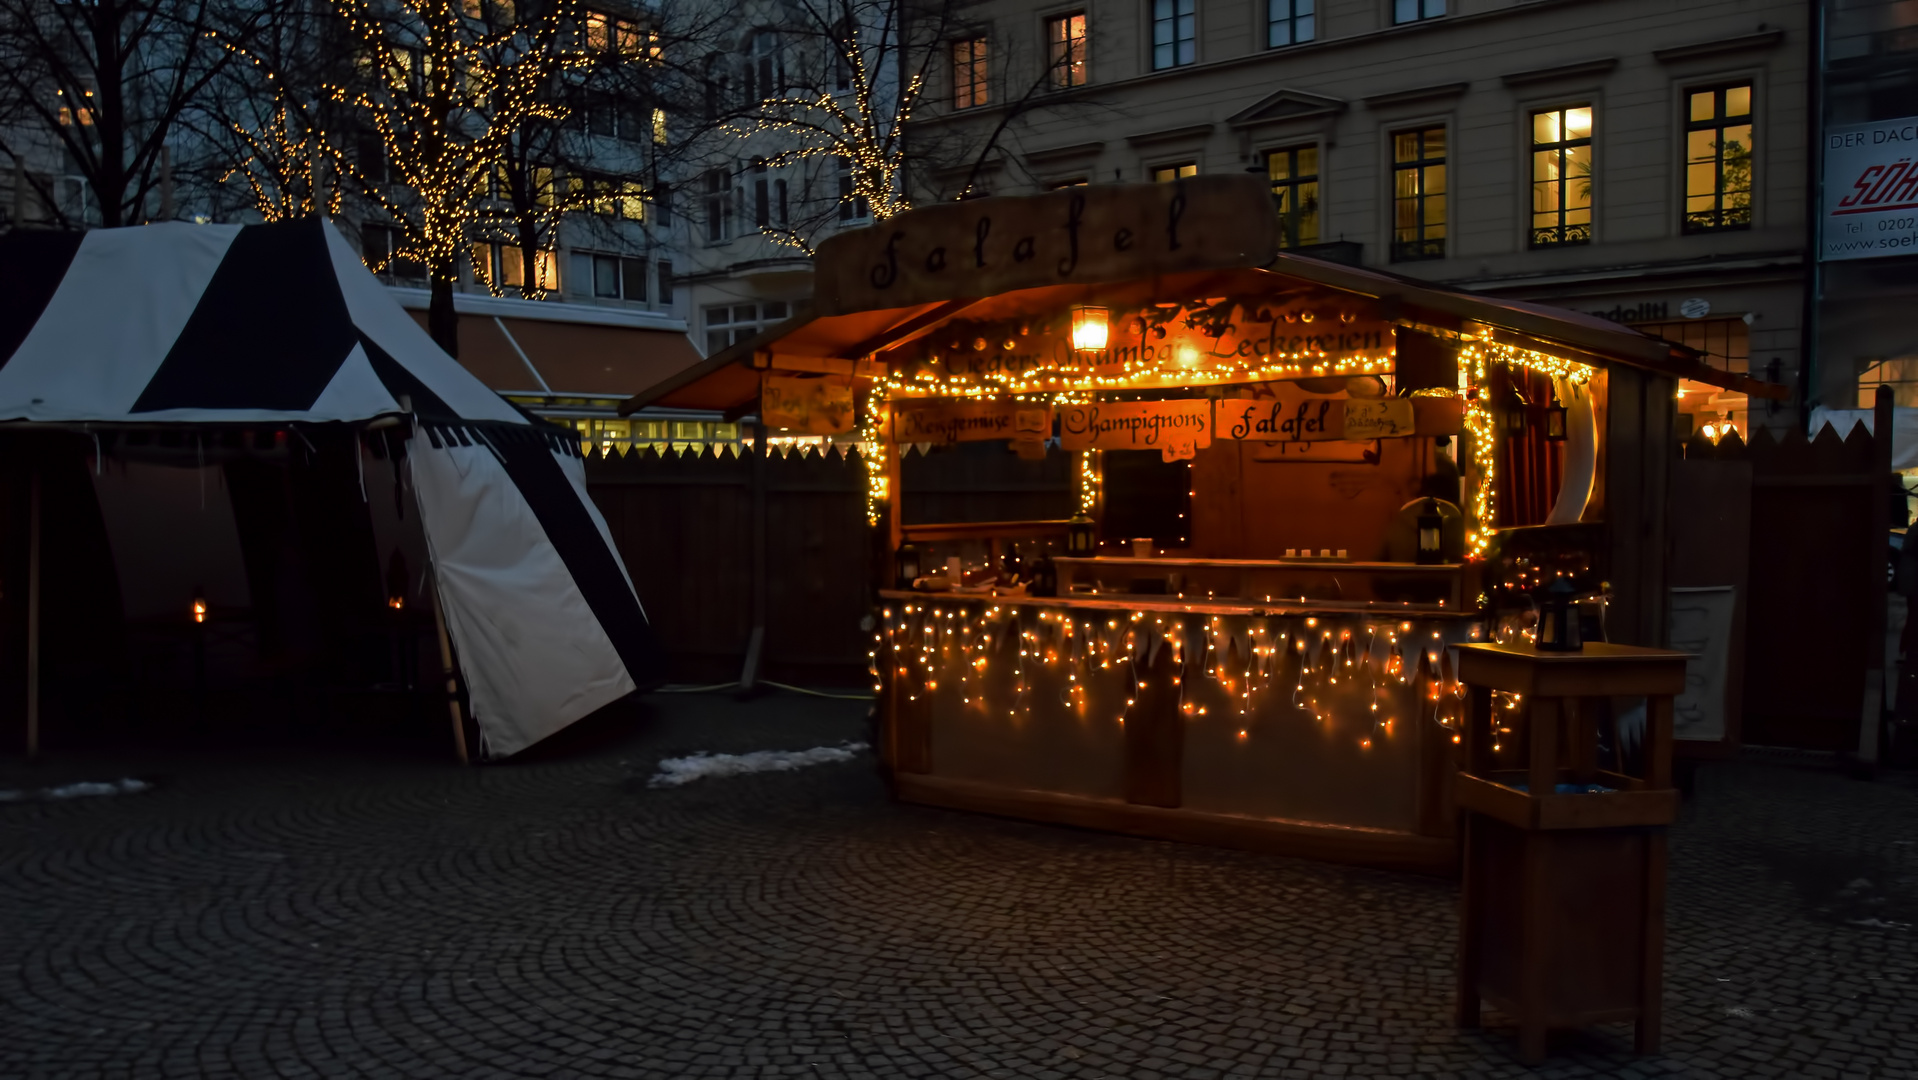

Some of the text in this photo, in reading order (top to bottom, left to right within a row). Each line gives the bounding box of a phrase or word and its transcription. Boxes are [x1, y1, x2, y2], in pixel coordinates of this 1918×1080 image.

[1830, 126, 1918, 149] DER DAC
[1838, 157, 1918, 207] SÖH
[1208, 314, 1383, 358] Leckereien
[1065, 406, 1205, 445] Champignons
